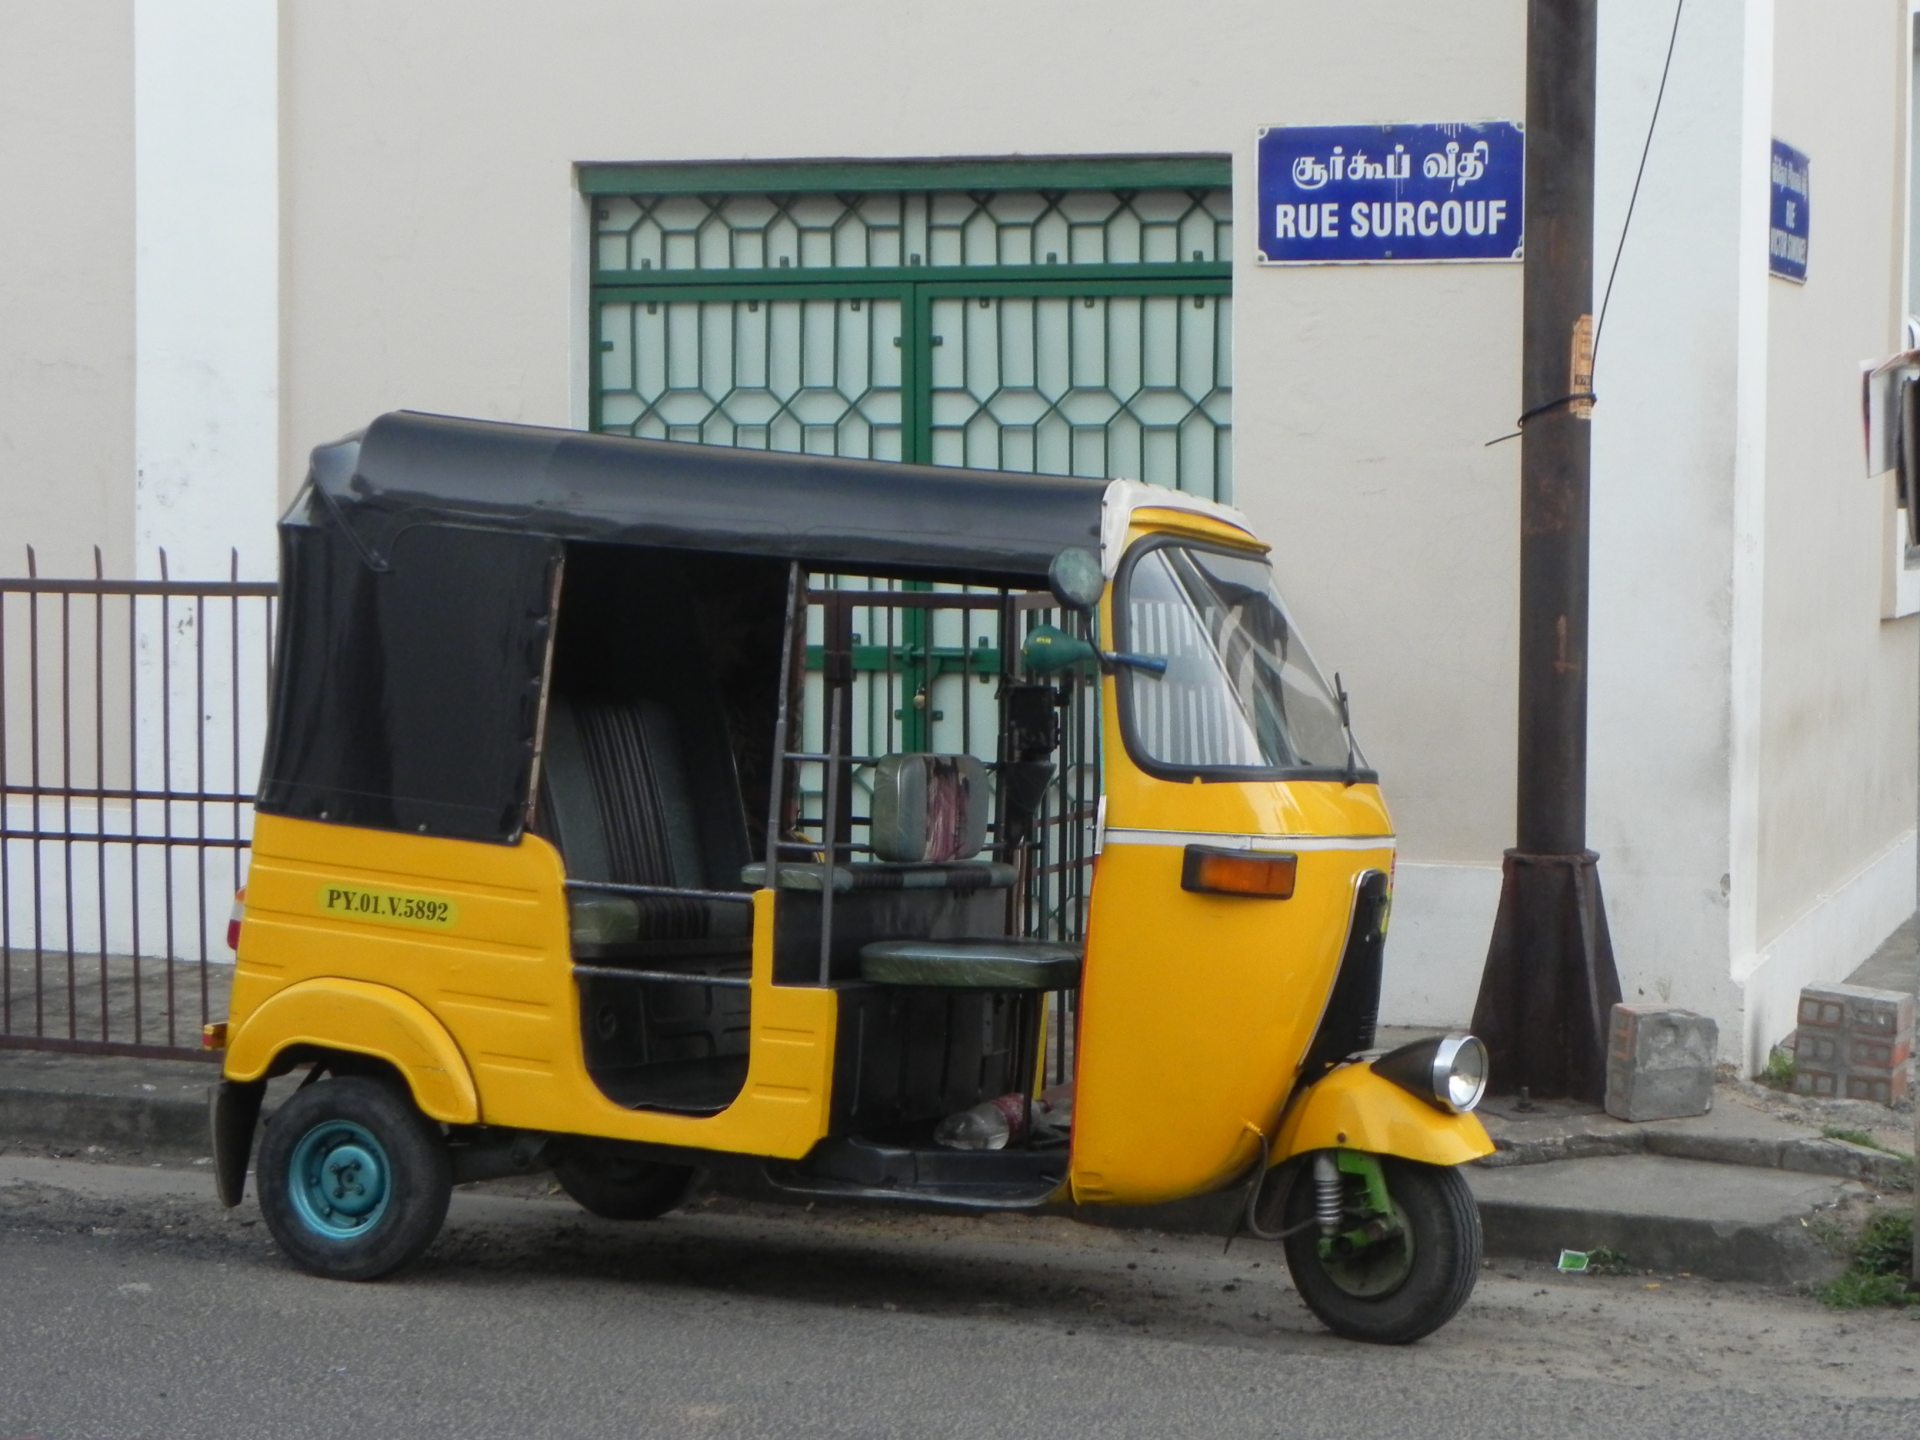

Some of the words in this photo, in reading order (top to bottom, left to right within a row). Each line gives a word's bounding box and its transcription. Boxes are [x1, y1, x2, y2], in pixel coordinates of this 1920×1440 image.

[1423, 140, 1489, 187] வீதி
[1276, 203, 1339, 238] RUE
[1350, 200, 1507, 238] SURCOUF
[327, 889, 449, 922] PY.01.V.5892
